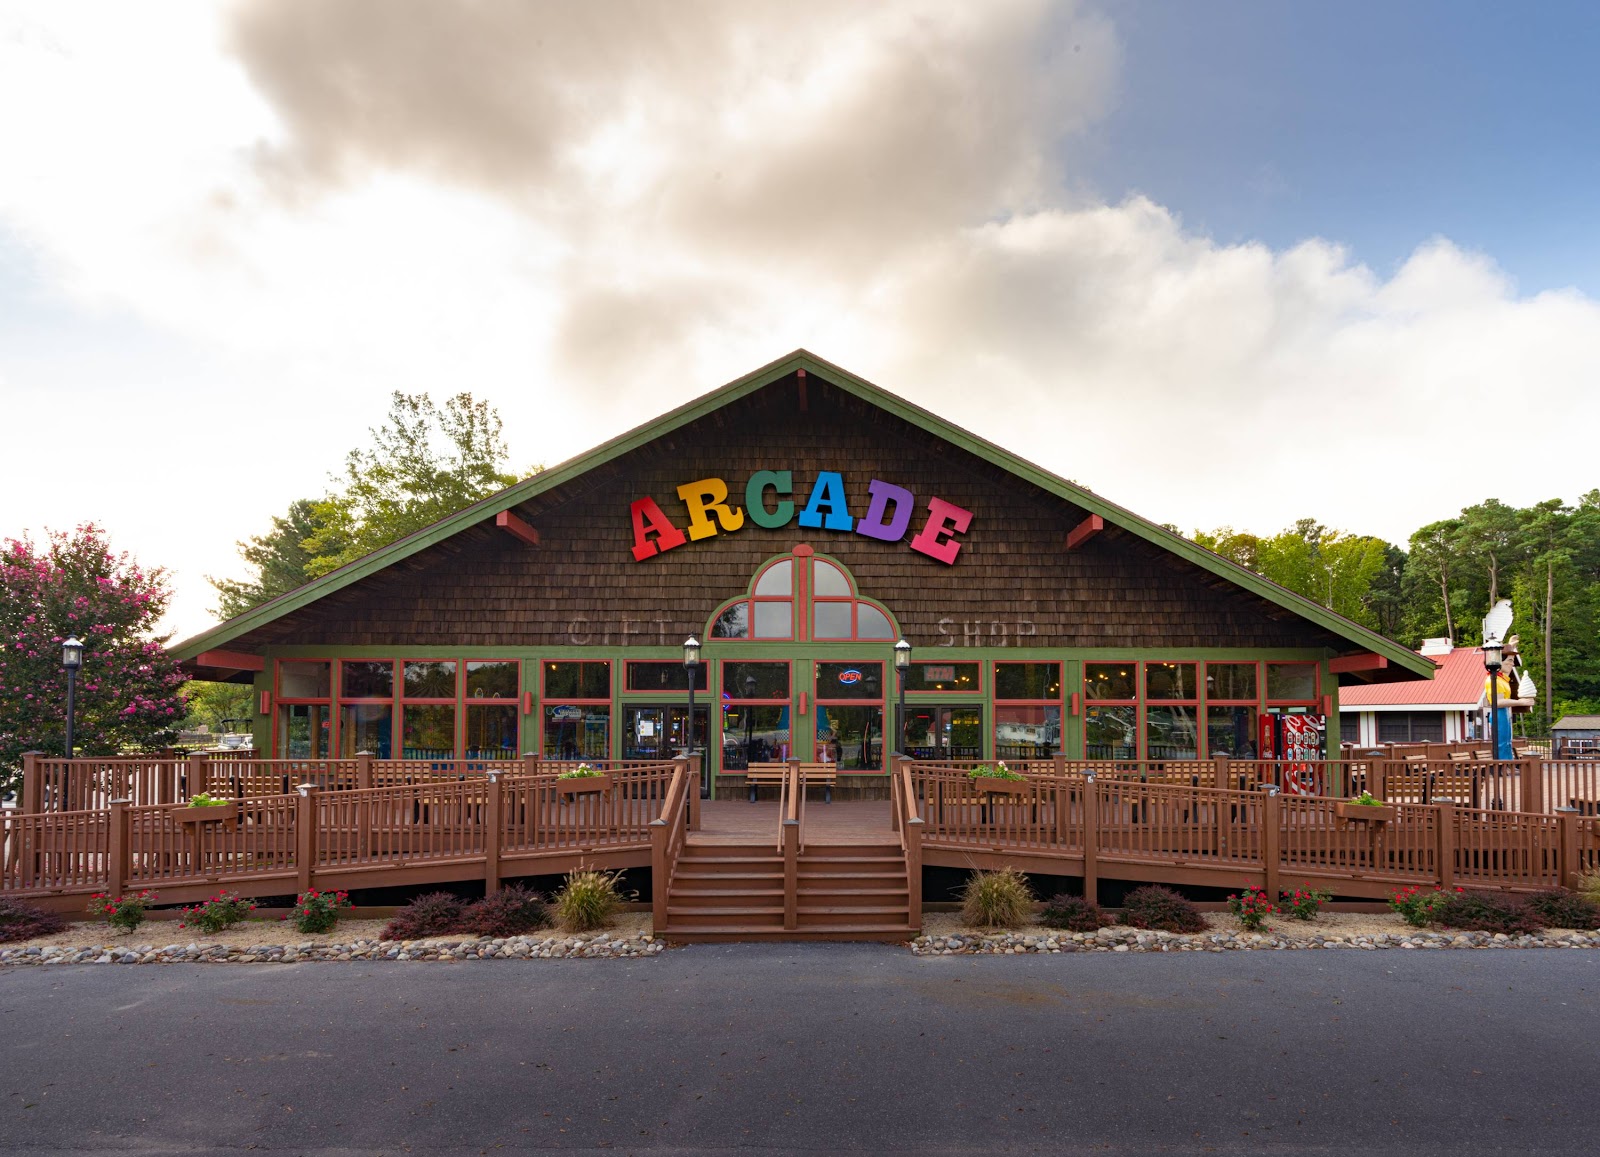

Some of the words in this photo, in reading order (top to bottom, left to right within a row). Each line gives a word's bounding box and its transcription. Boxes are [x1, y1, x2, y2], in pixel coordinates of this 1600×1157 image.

[630, 470, 974, 565] ARCADE
[938, 617, 1036, 647] SHOP
[838, 672, 862, 681] OPEN
[927, 667, 955, 680] ATM
